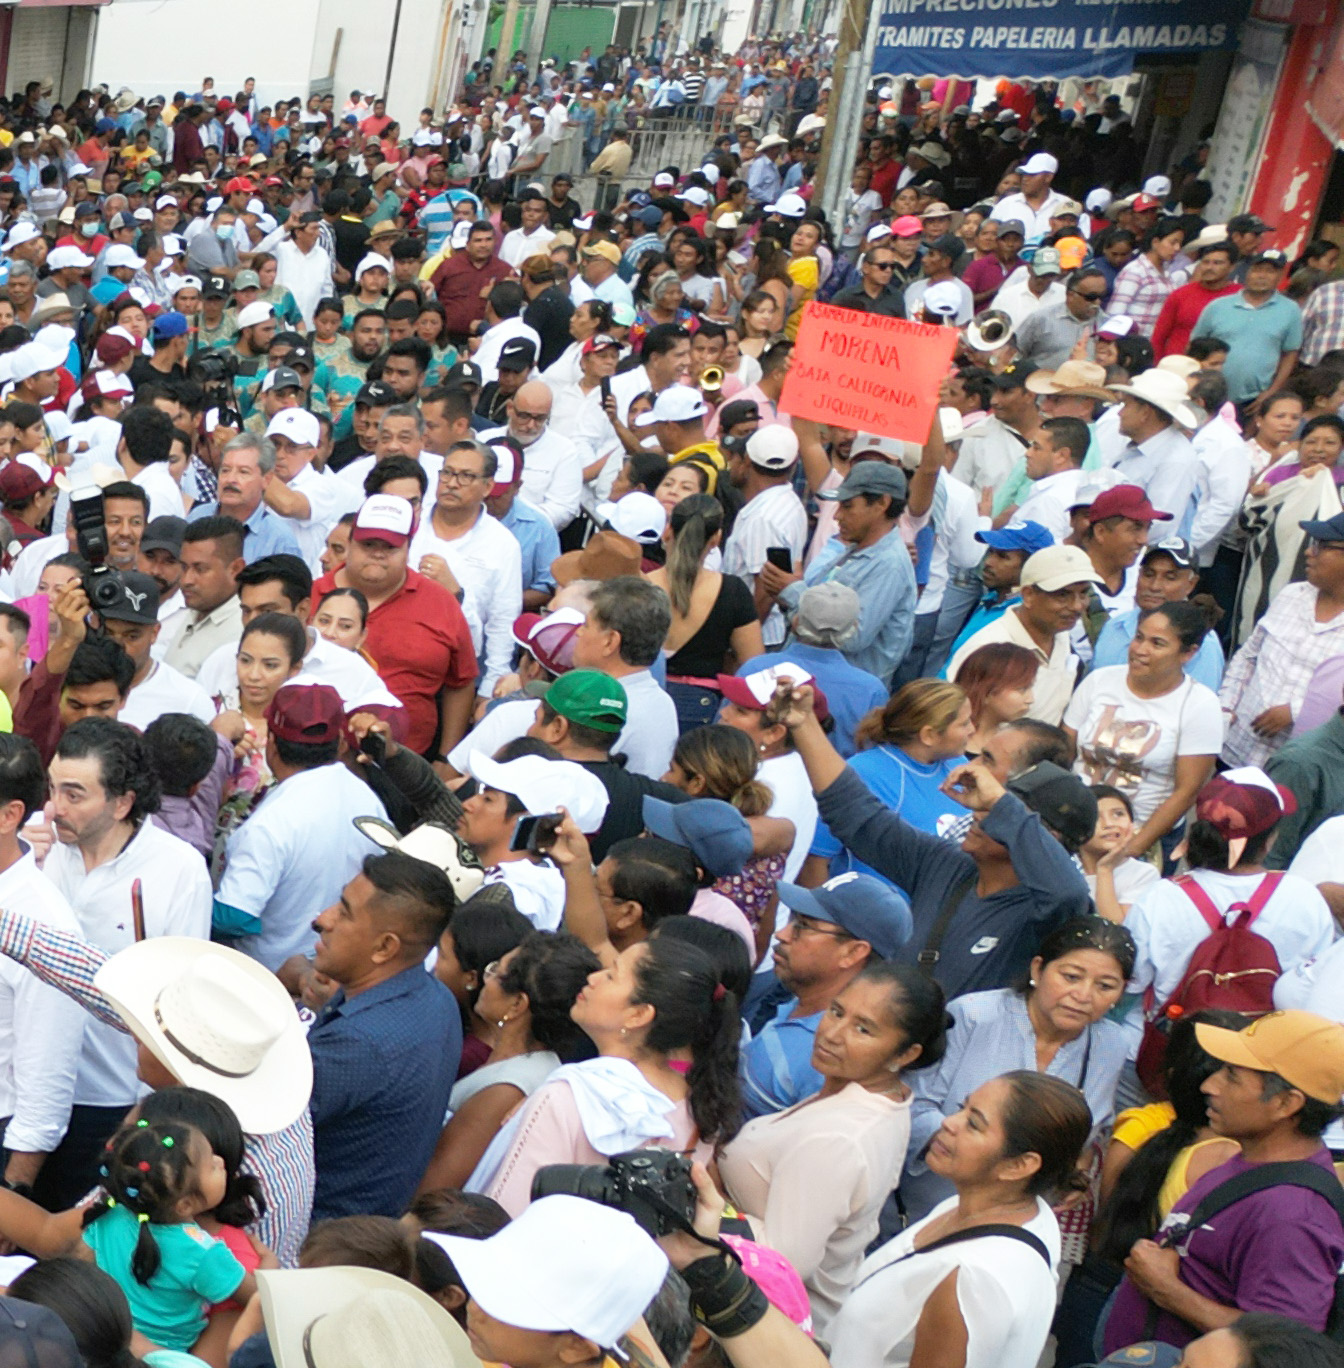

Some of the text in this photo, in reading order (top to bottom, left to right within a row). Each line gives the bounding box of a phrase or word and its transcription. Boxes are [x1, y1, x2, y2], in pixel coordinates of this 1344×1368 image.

[969, 26, 1077, 49] PAPELERIA
[1082, 24, 1227, 50] LLAMADAS
[820, 329, 901, 372] MORENA
